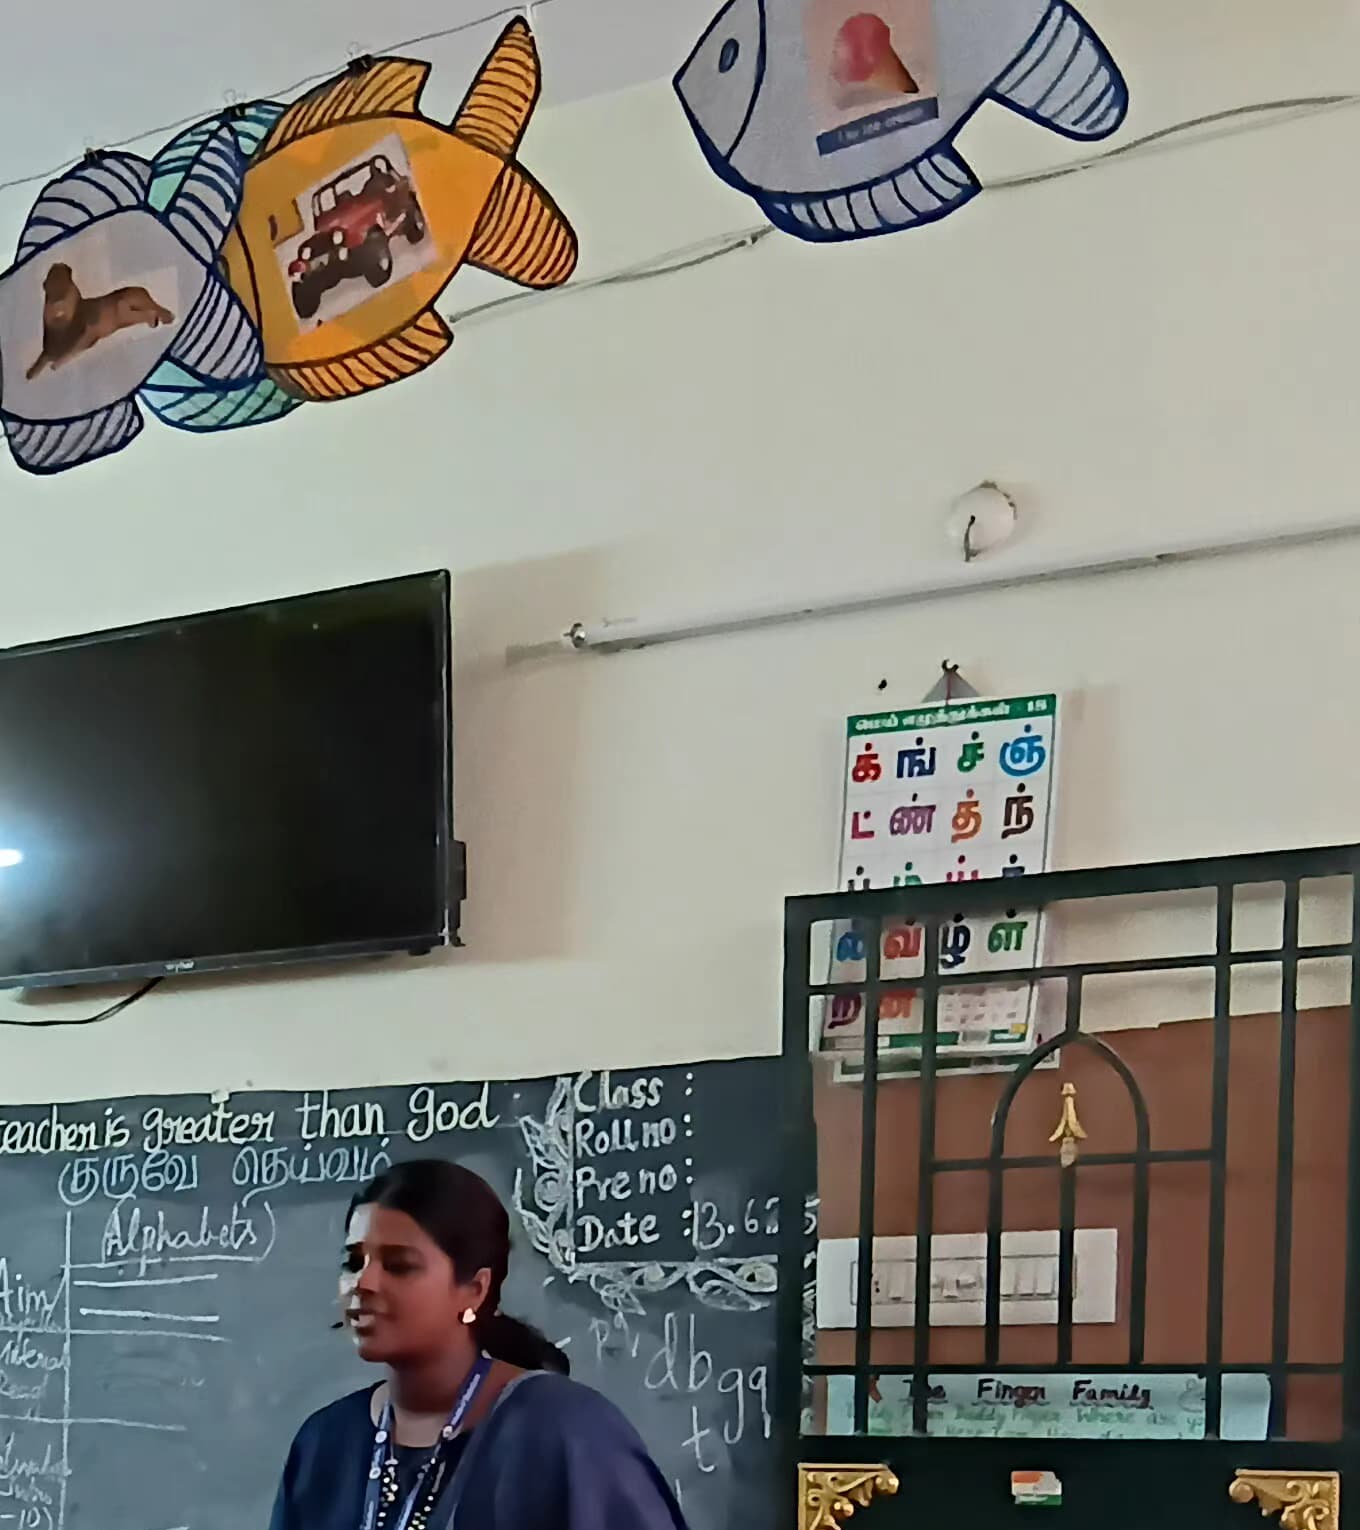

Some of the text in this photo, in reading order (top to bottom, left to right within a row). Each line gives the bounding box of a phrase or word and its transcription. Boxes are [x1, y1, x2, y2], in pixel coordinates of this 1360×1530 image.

[852, 723, 1046, 783] க் ங் ச் ஞ்
[851, 782, 1034, 843] ட் ண் த் ந்
[574, 1071, 663, 1113] Class
[103, 1107, 130, 1148] is
[142, 1103, 274, 1153] greater
[295, 1089, 384, 1139] than
[575, 1119, 638, 1158] Roll
[58, 1150, 197, 1206] குருவே
[576, 1164, 677, 1208] Pre no
[577, 1209, 660, 1252] Date
